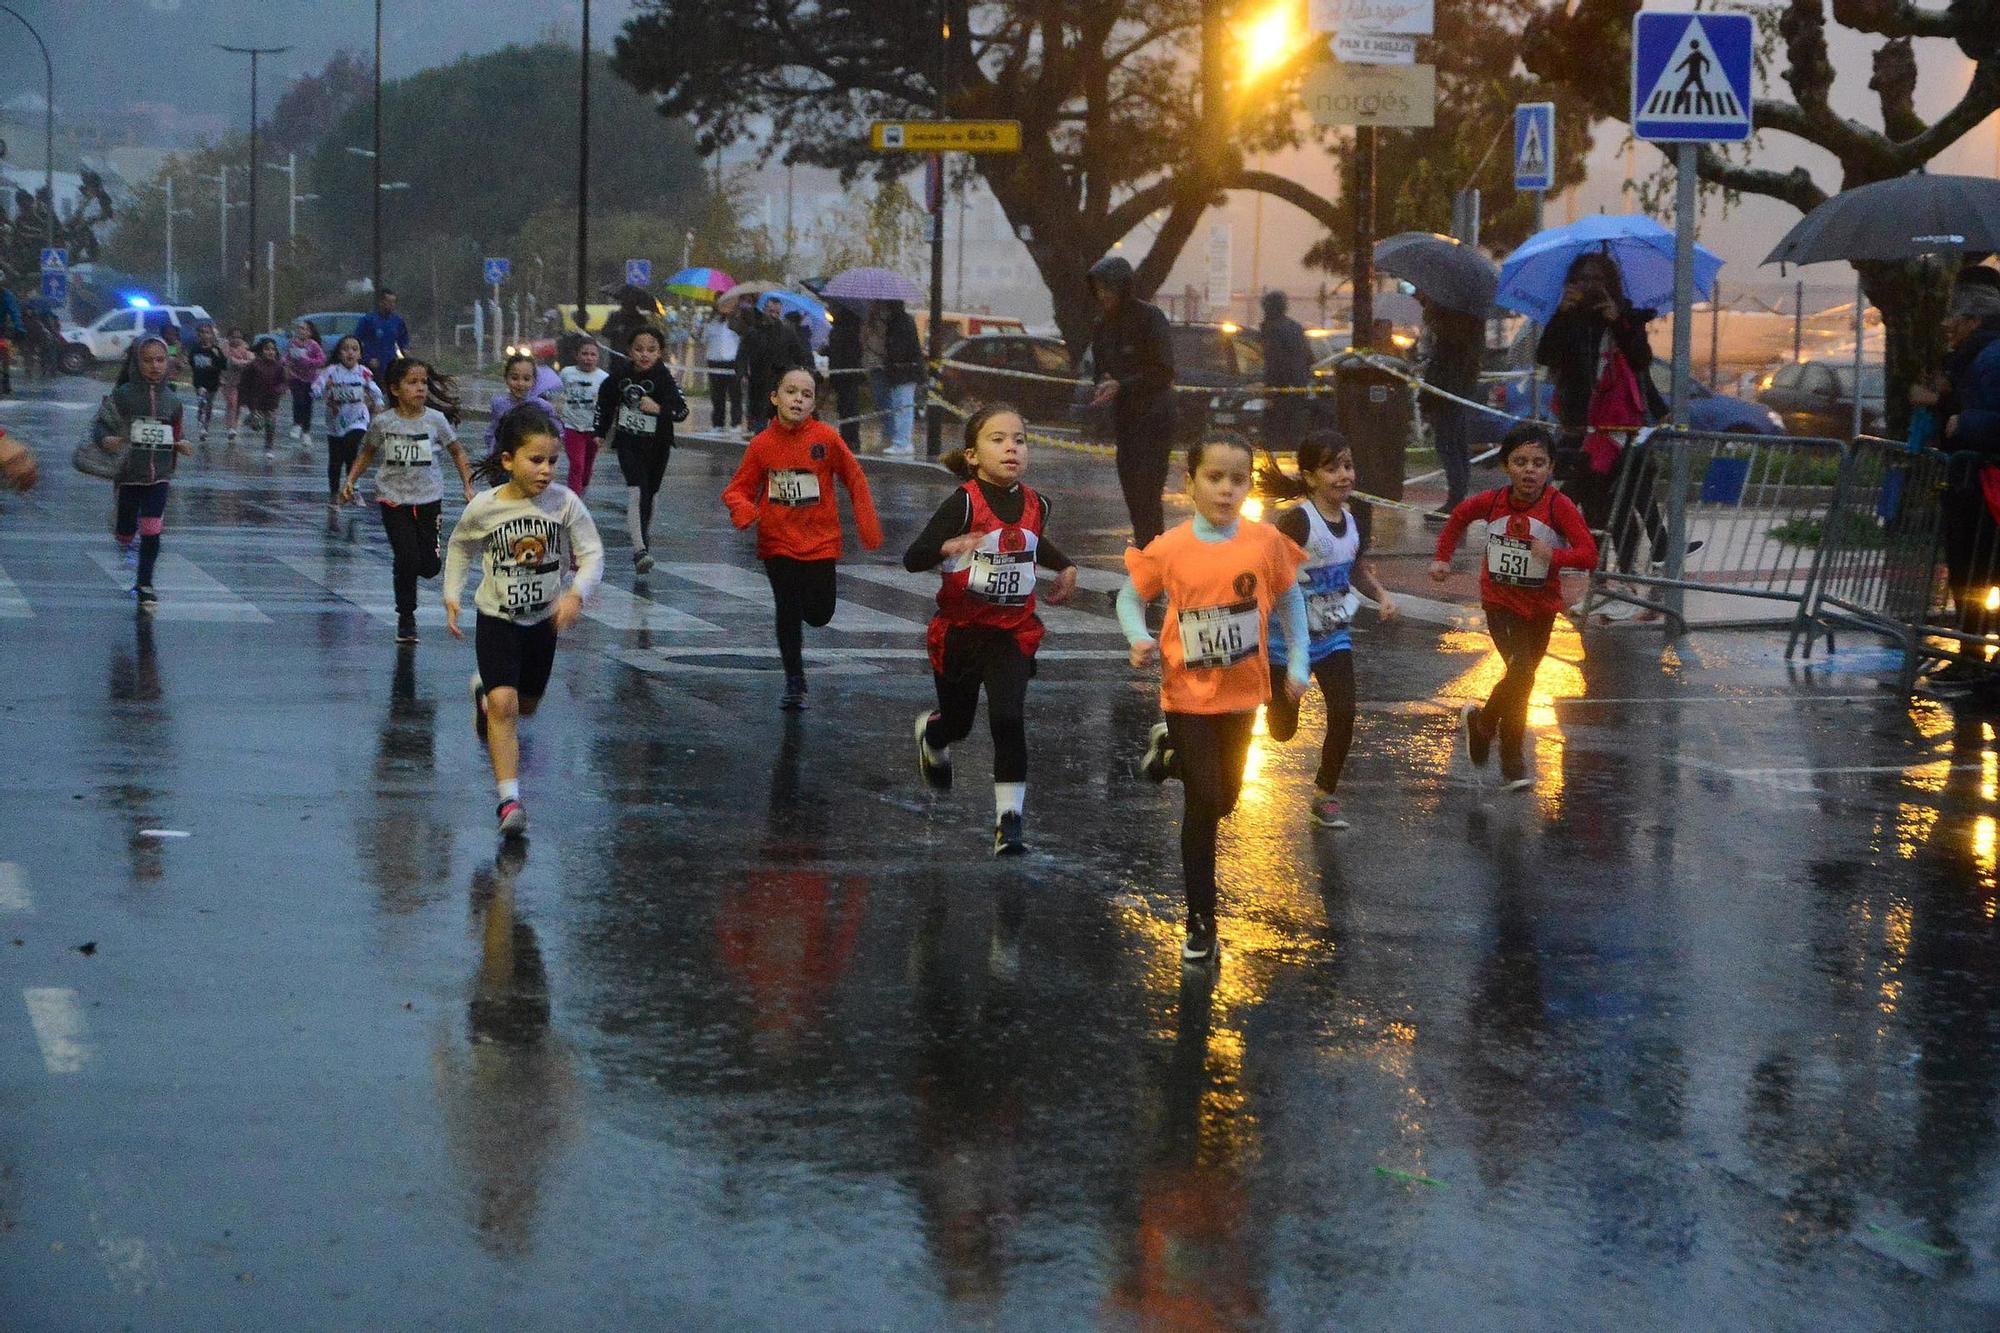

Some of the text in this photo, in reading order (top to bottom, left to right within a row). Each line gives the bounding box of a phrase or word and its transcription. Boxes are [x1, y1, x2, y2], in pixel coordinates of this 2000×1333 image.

[1339, 39, 1360, 49] PAN
[1316, 90, 1410, 112] nordés
[967, 129, 997, 141] BUS
[142, 427, 164, 443] 559
[394, 445, 419, 460] 570
[778, 481, 801, 499] 551
[1500, 553, 1529, 576] 531
[985, 571, 1021, 595] 568
[507, 581, 543, 606] 535
[1199, 623, 1242, 655] 546
